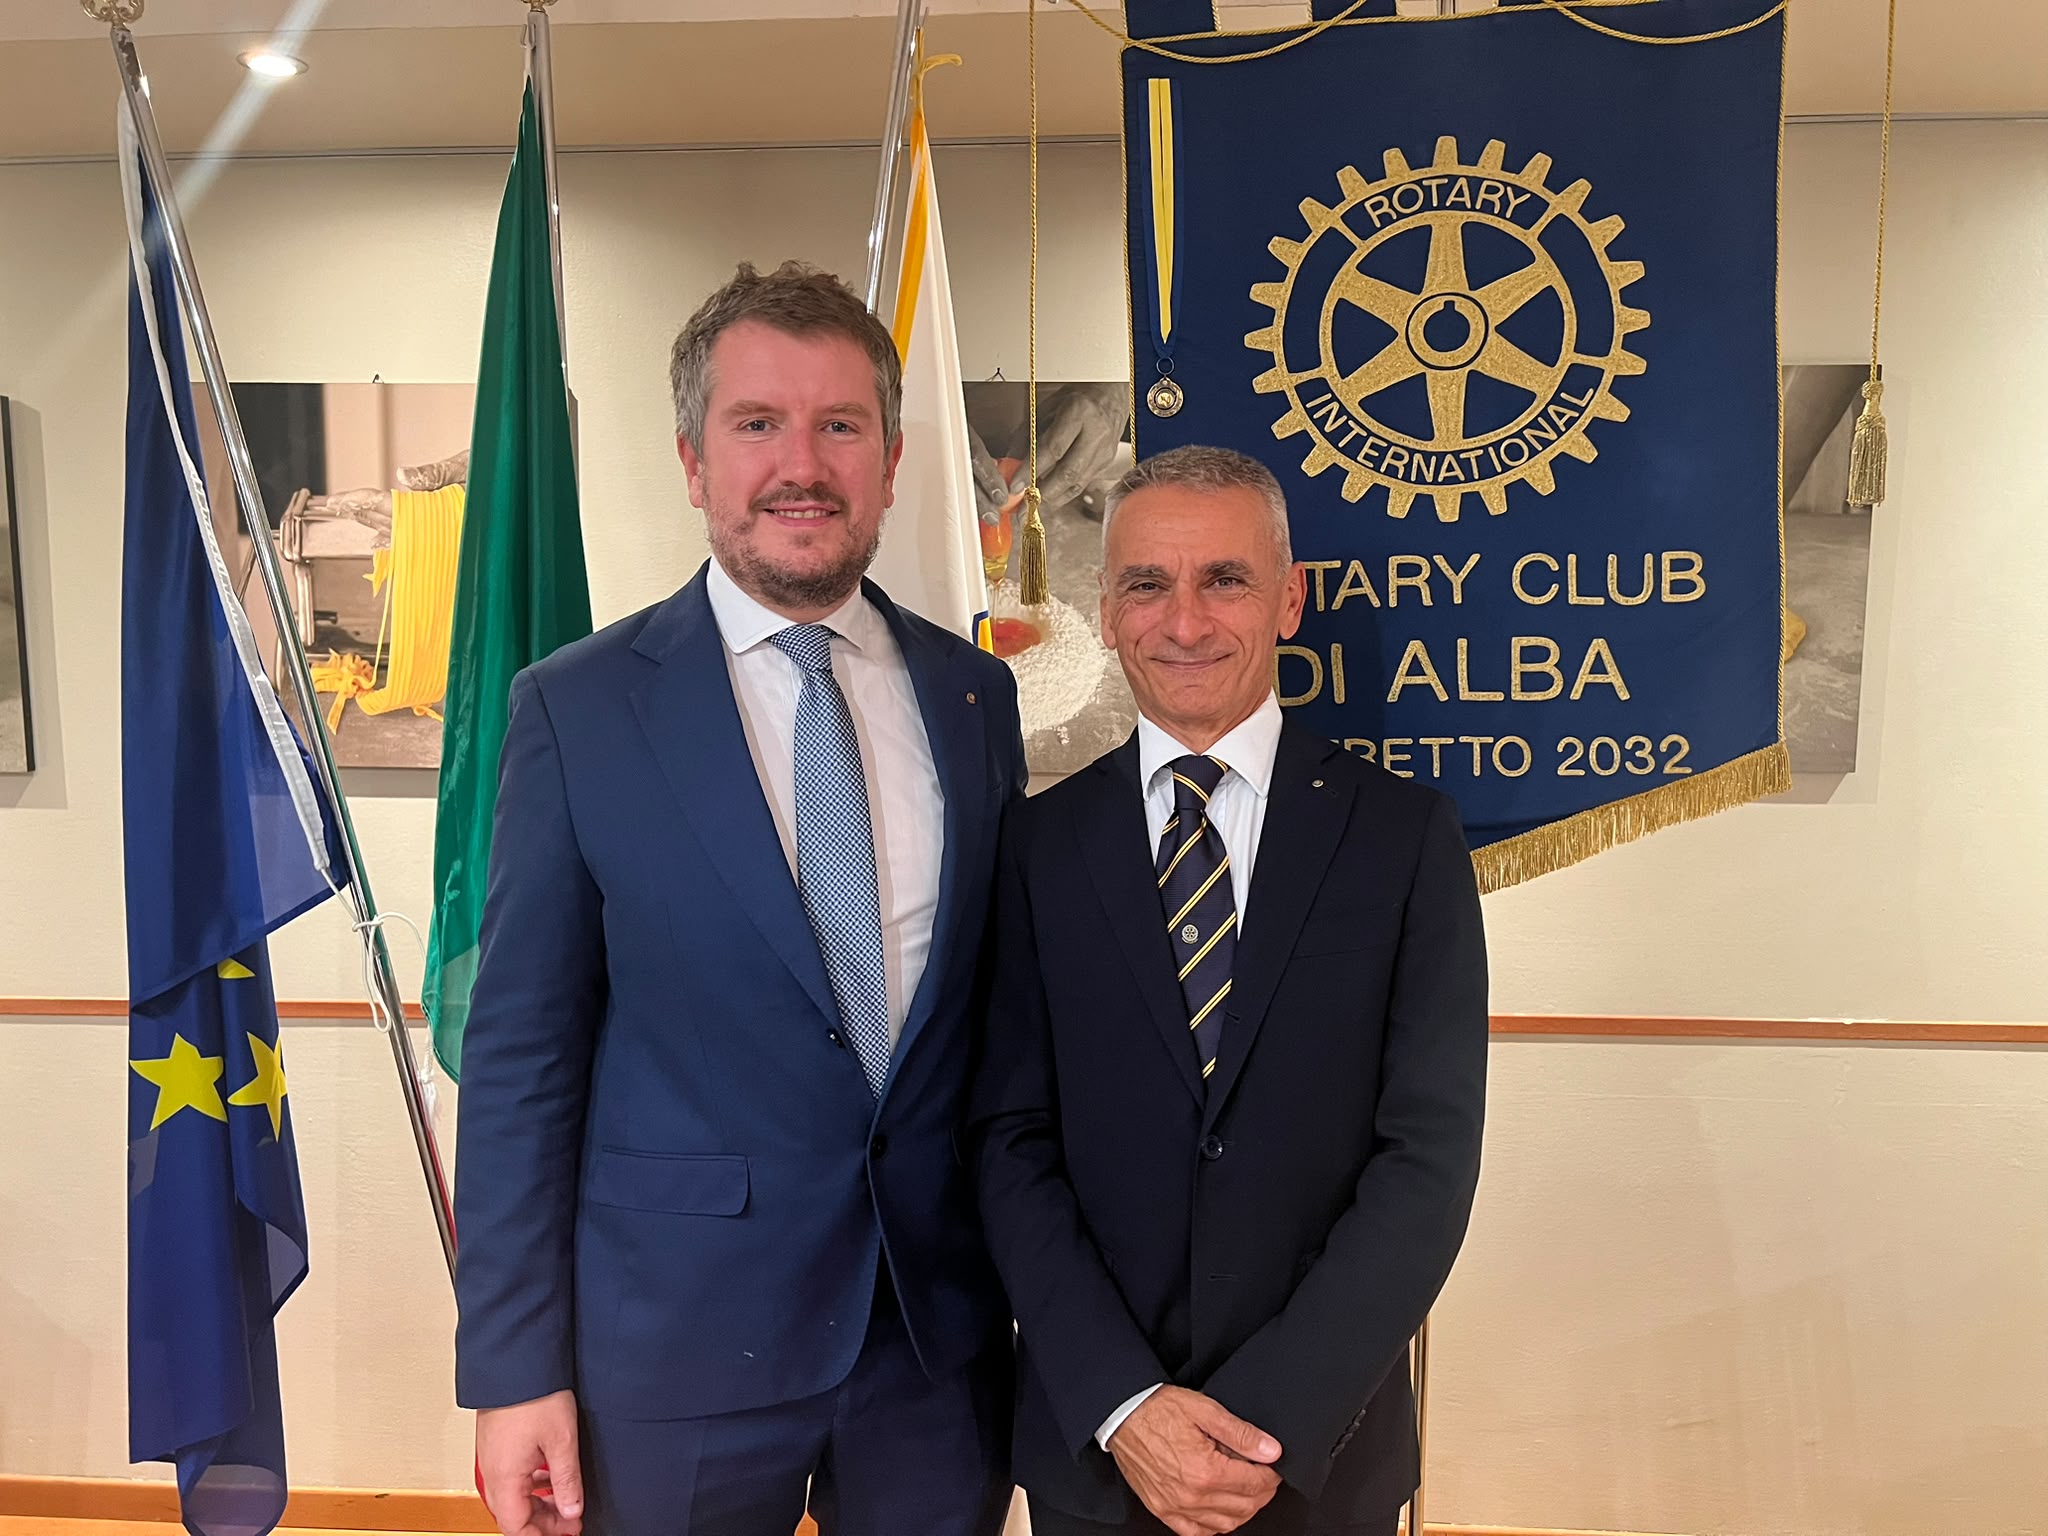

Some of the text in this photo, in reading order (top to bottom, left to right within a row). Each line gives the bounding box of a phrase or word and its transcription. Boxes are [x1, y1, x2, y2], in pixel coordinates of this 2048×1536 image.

[1364, 177, 1531, 228] ROTARY
[1305, 387, 1594, 482] INTERNATIONAL
[1303, 551, 1706, 612] TARY CLUB
[1271, 636, 1631, 707] DI ALBA
[1556, 734, 1692, 777] 2032
